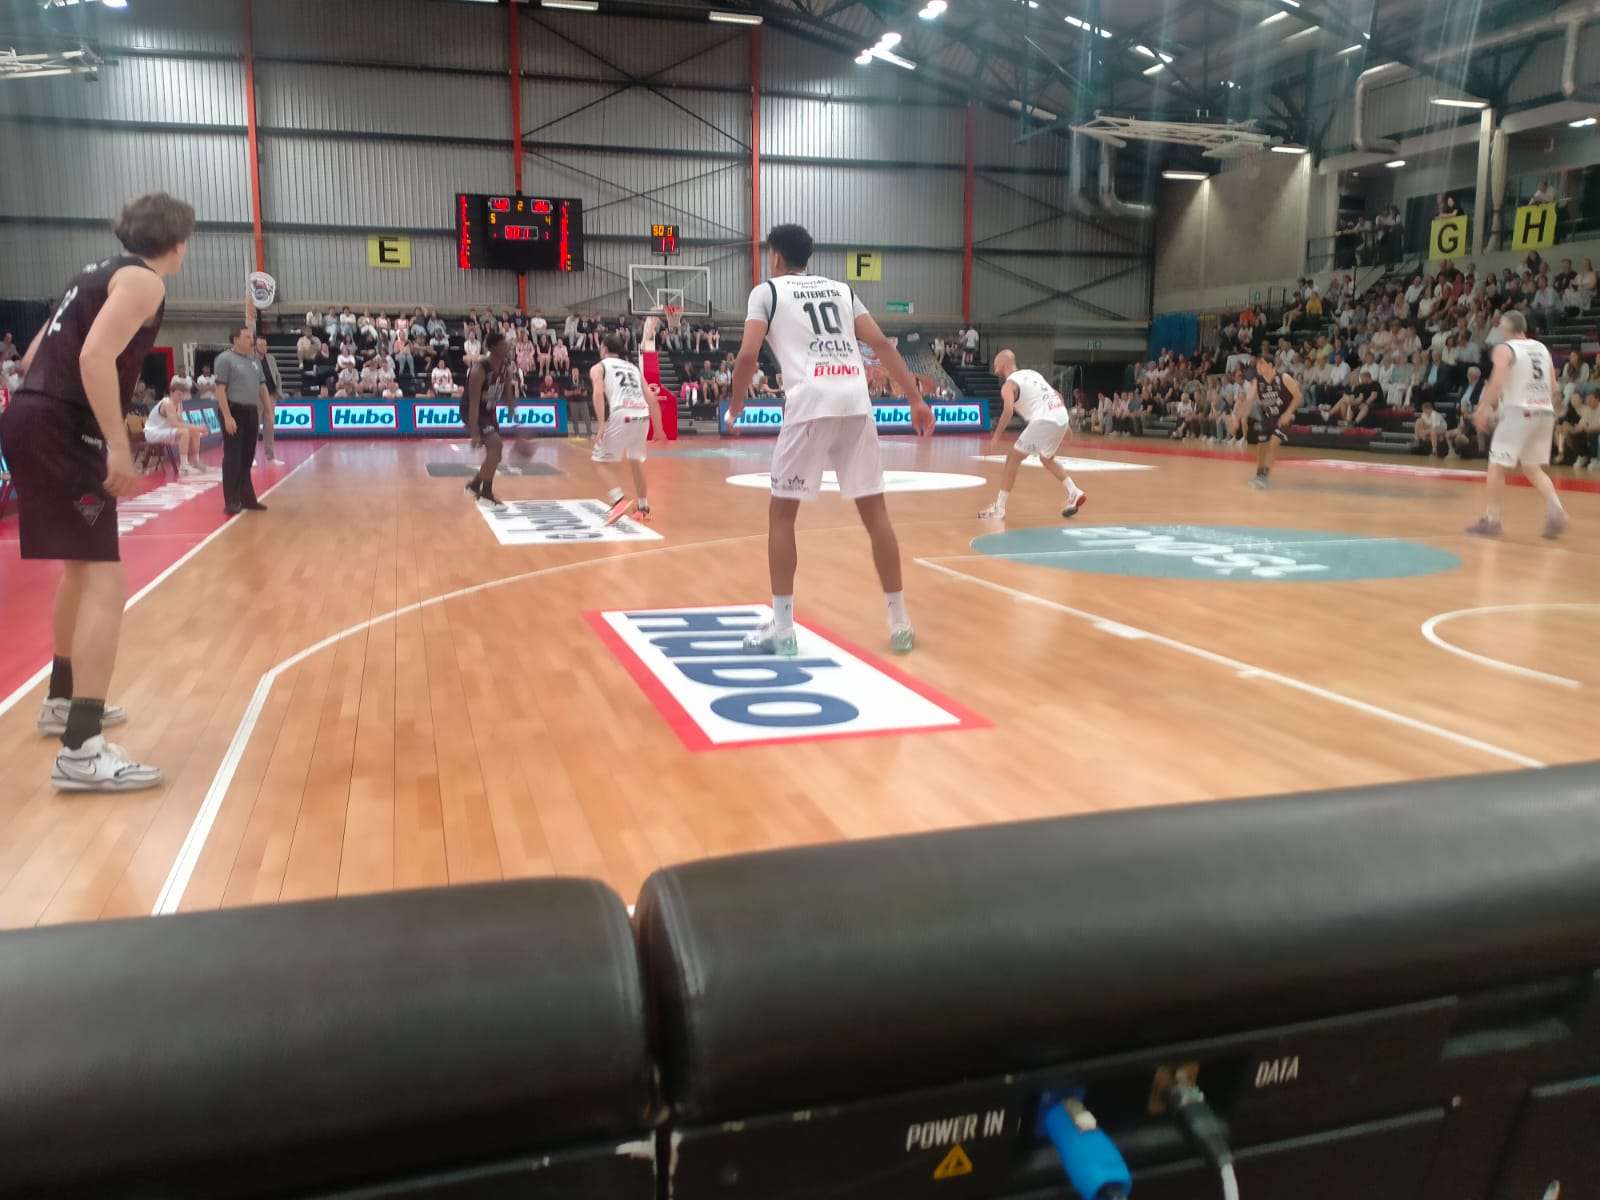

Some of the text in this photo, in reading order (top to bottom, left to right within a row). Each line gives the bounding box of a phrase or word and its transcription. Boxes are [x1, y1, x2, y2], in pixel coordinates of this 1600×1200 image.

[1437, 224, 1458, 253] G
[1522, 210, 1547, 243] H
[379, 236, 400, 263] E
[857, 253, 871, 276] F
[803, 302, 842, 335] 10
[334, 409, 393, 425] Hubo
[418, 408, 461, 424] Hub
[499, 408, 553, 424] Hubo
[934, 407, 979, 422] Hubo
[1255, 1056, 1299, 1088] DATA
[907, 1109, 1005, 1152] POWER IN
